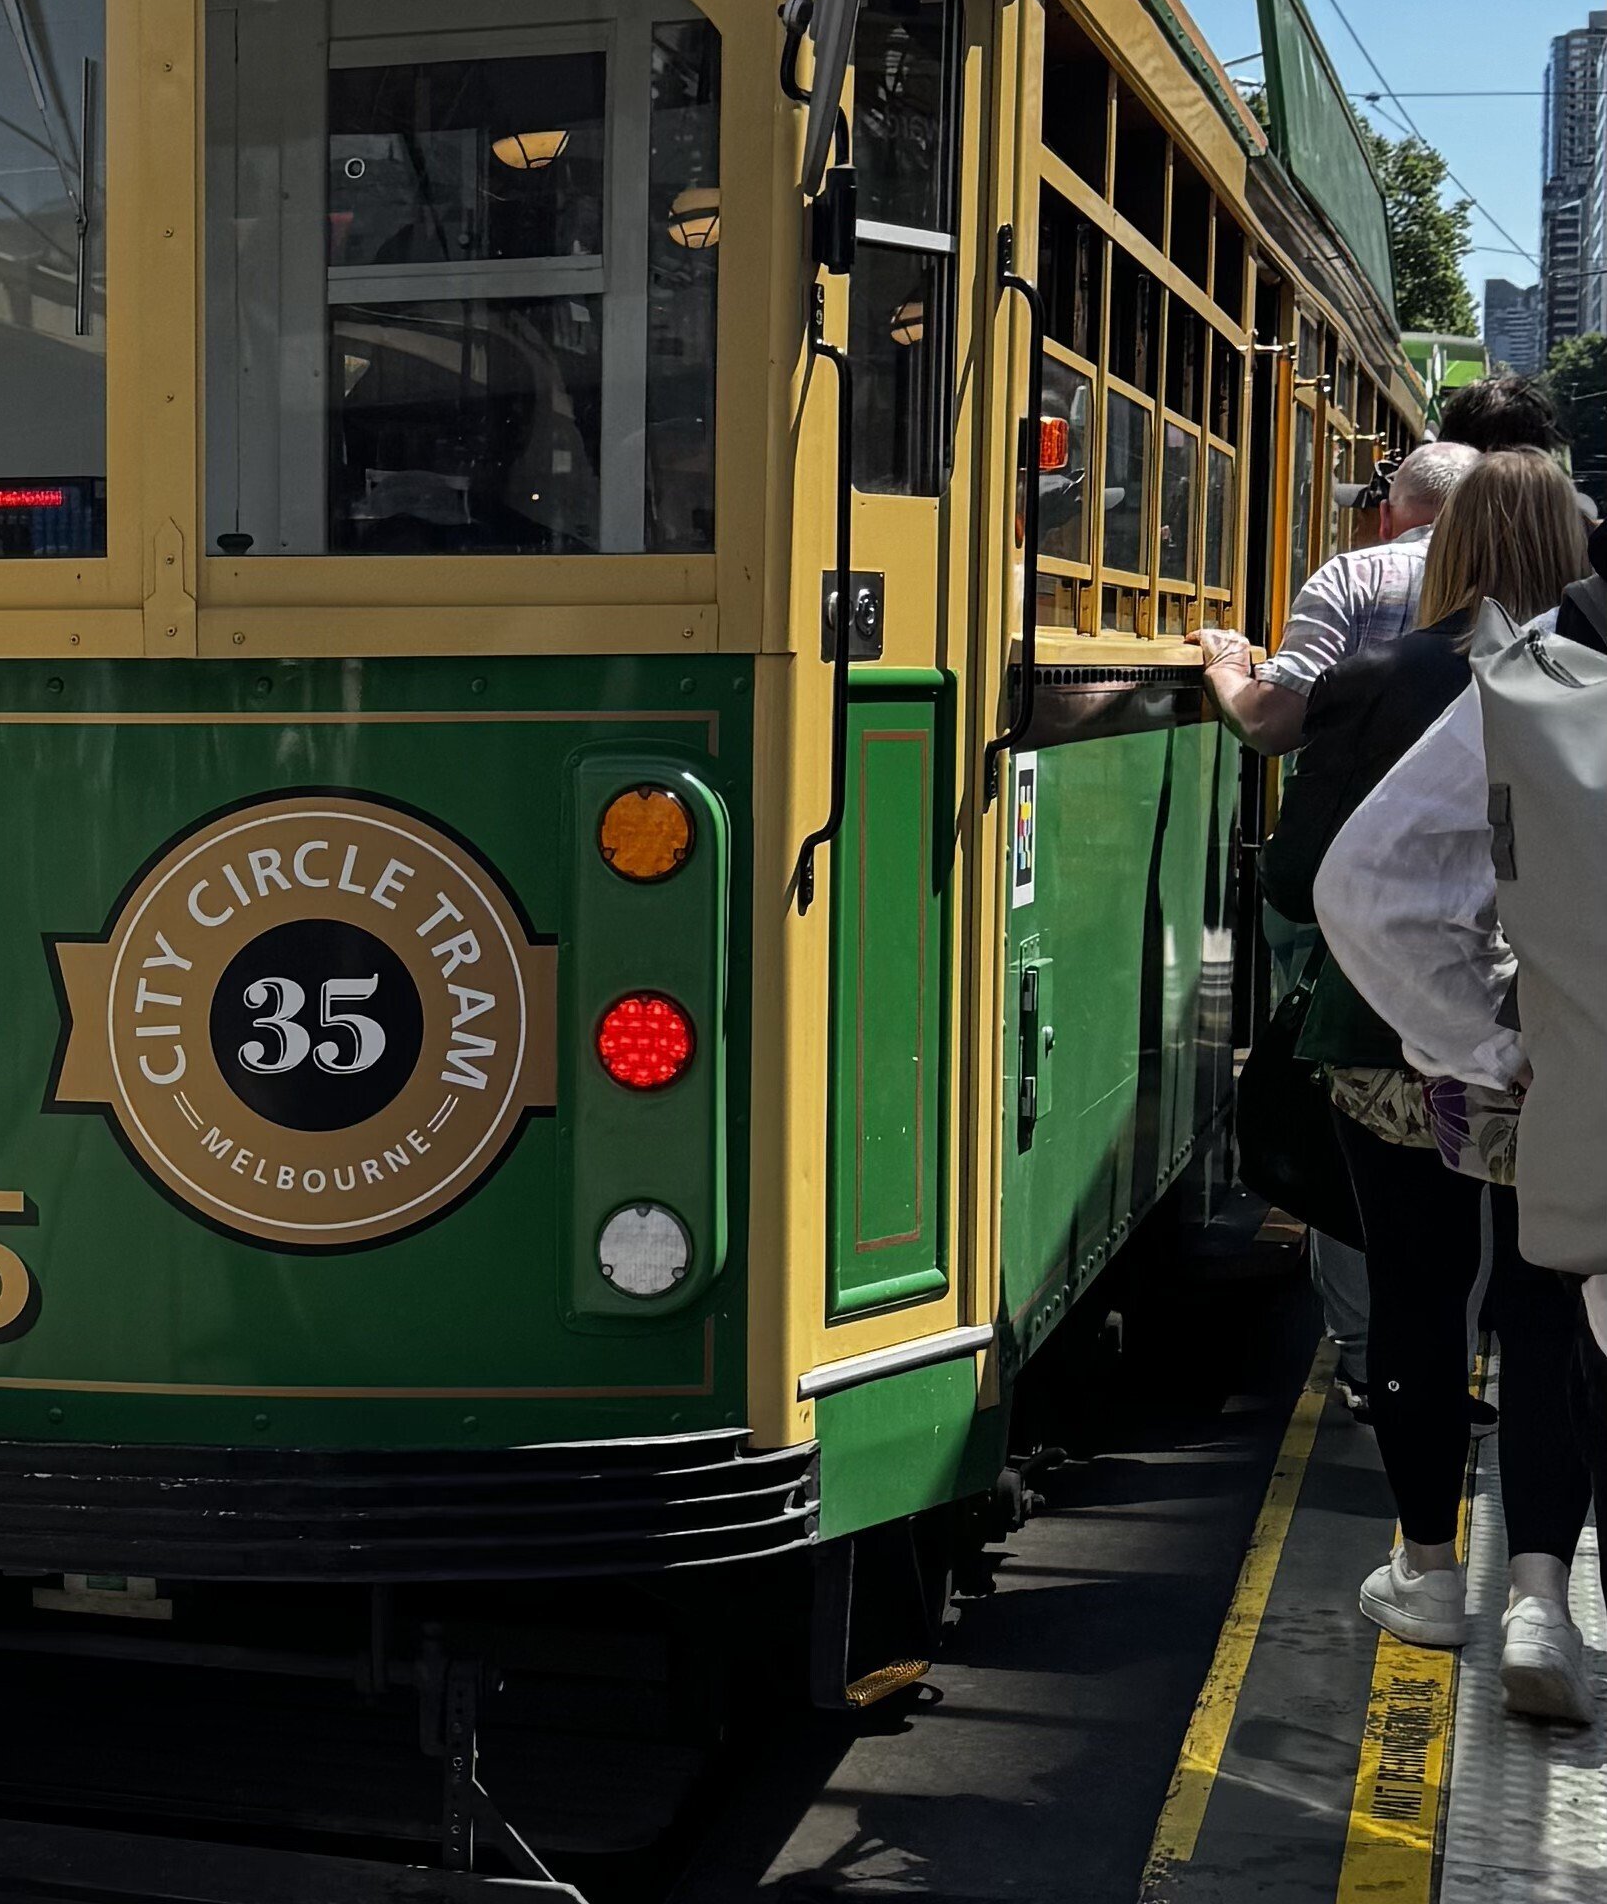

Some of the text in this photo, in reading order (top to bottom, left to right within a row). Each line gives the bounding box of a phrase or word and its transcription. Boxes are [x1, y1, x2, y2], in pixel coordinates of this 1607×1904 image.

[134, 840, 498, 1091] CITY CIRCLE TRAM
[237, 973, 387, 1075] 35
[200, 1126, 432, 1194] MELBOURNE
[1370, 1785, 1423, 1821] WAIT
